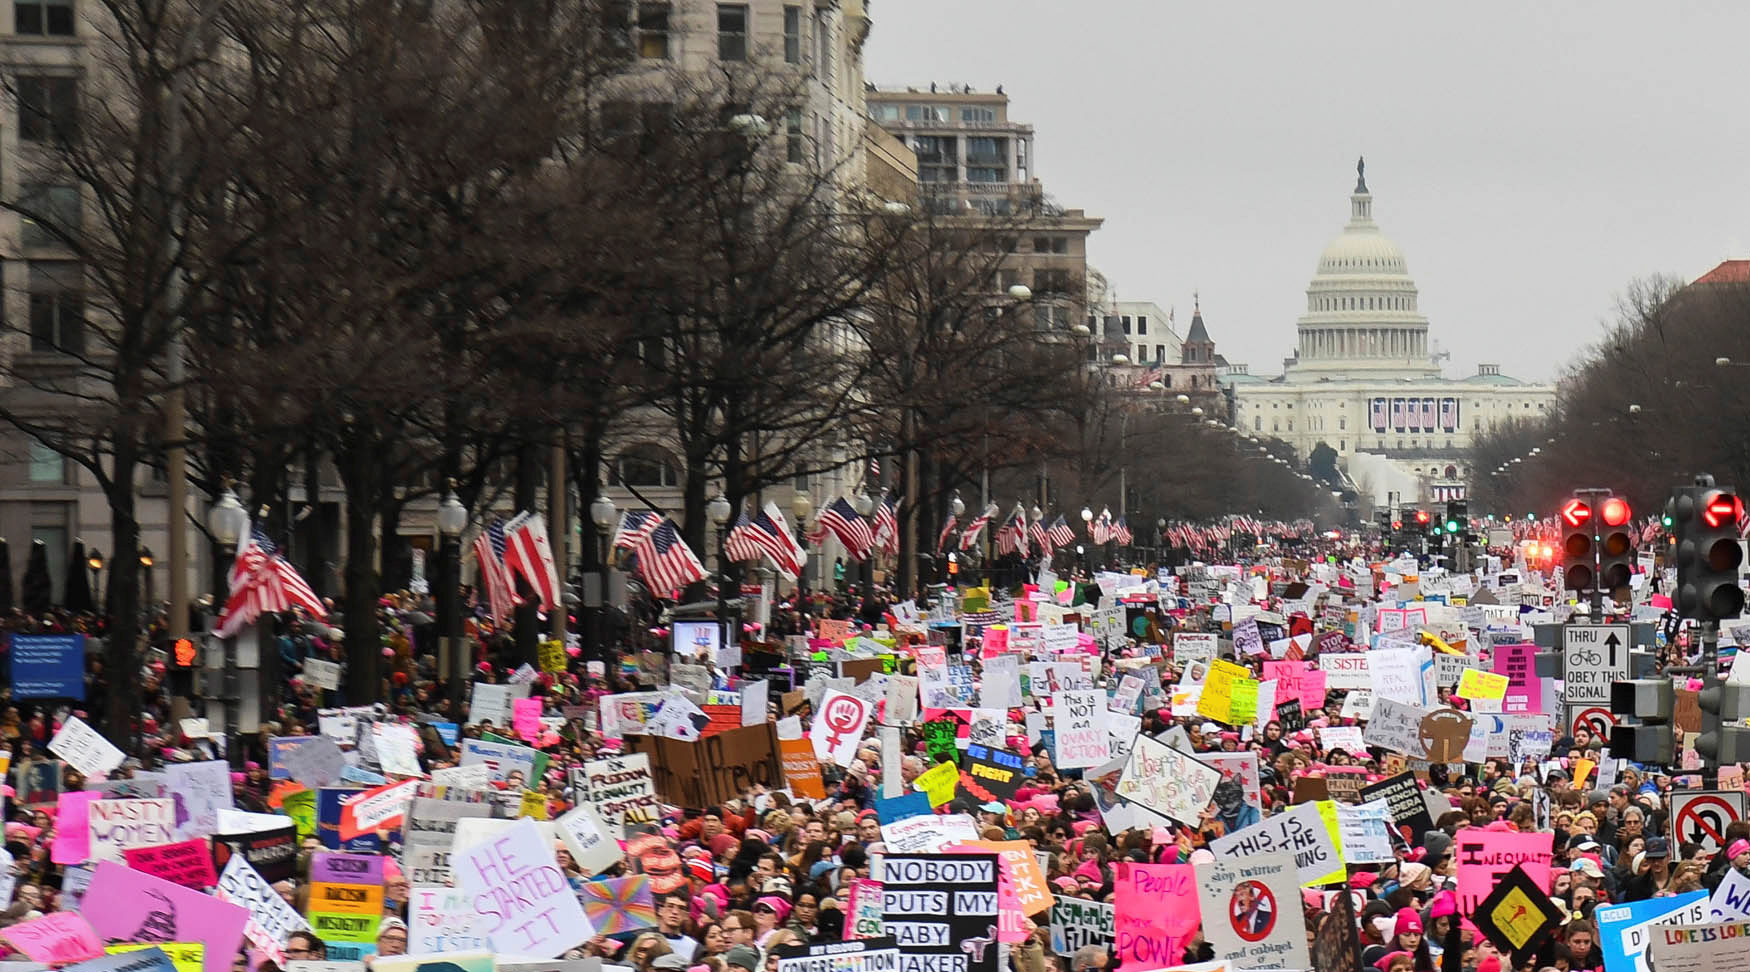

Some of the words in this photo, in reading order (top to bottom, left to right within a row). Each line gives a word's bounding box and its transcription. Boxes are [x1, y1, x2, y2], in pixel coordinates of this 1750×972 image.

[1569, 631, 1597, 643] THRU
[1568, 672, 1596, 683] OBEY
[1602, 671, 1625, 682] THIS
[1568, 686, 1606, 697] SIGNAL
[625, 810, 658, 823] ALL
[470, 837, 528, 886] HE
[886, 863, 991, 881] NOBODY
[474, 865, 565, 932] STARTED
[885, 894, 944, 912] PUTS
[958, 895, 995, 912] MY
[515, 907, 559, 950] IT
